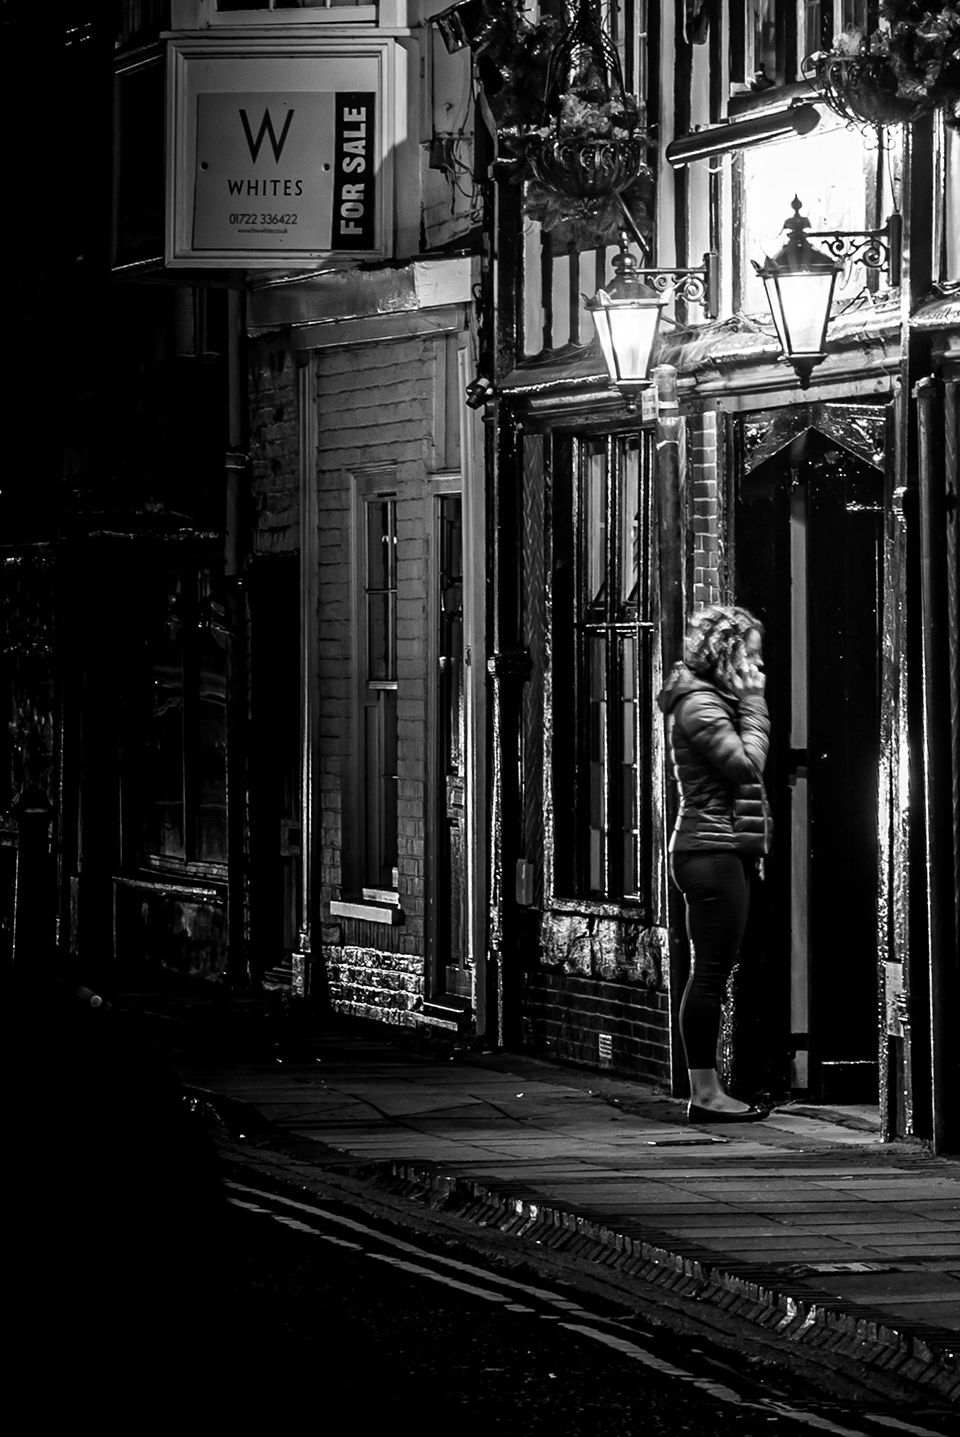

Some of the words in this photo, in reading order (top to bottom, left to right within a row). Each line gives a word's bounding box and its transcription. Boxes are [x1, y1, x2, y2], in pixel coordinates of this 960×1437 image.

[239, 108, 294, 164] W
[342, 107, 366, 173] SALE
[228, 180, 302, 195] WHITES
[340, 183, 364, 235] FOR
[229, 214, 257, 224] 01722
[260, 214, 297, 224] 336422
